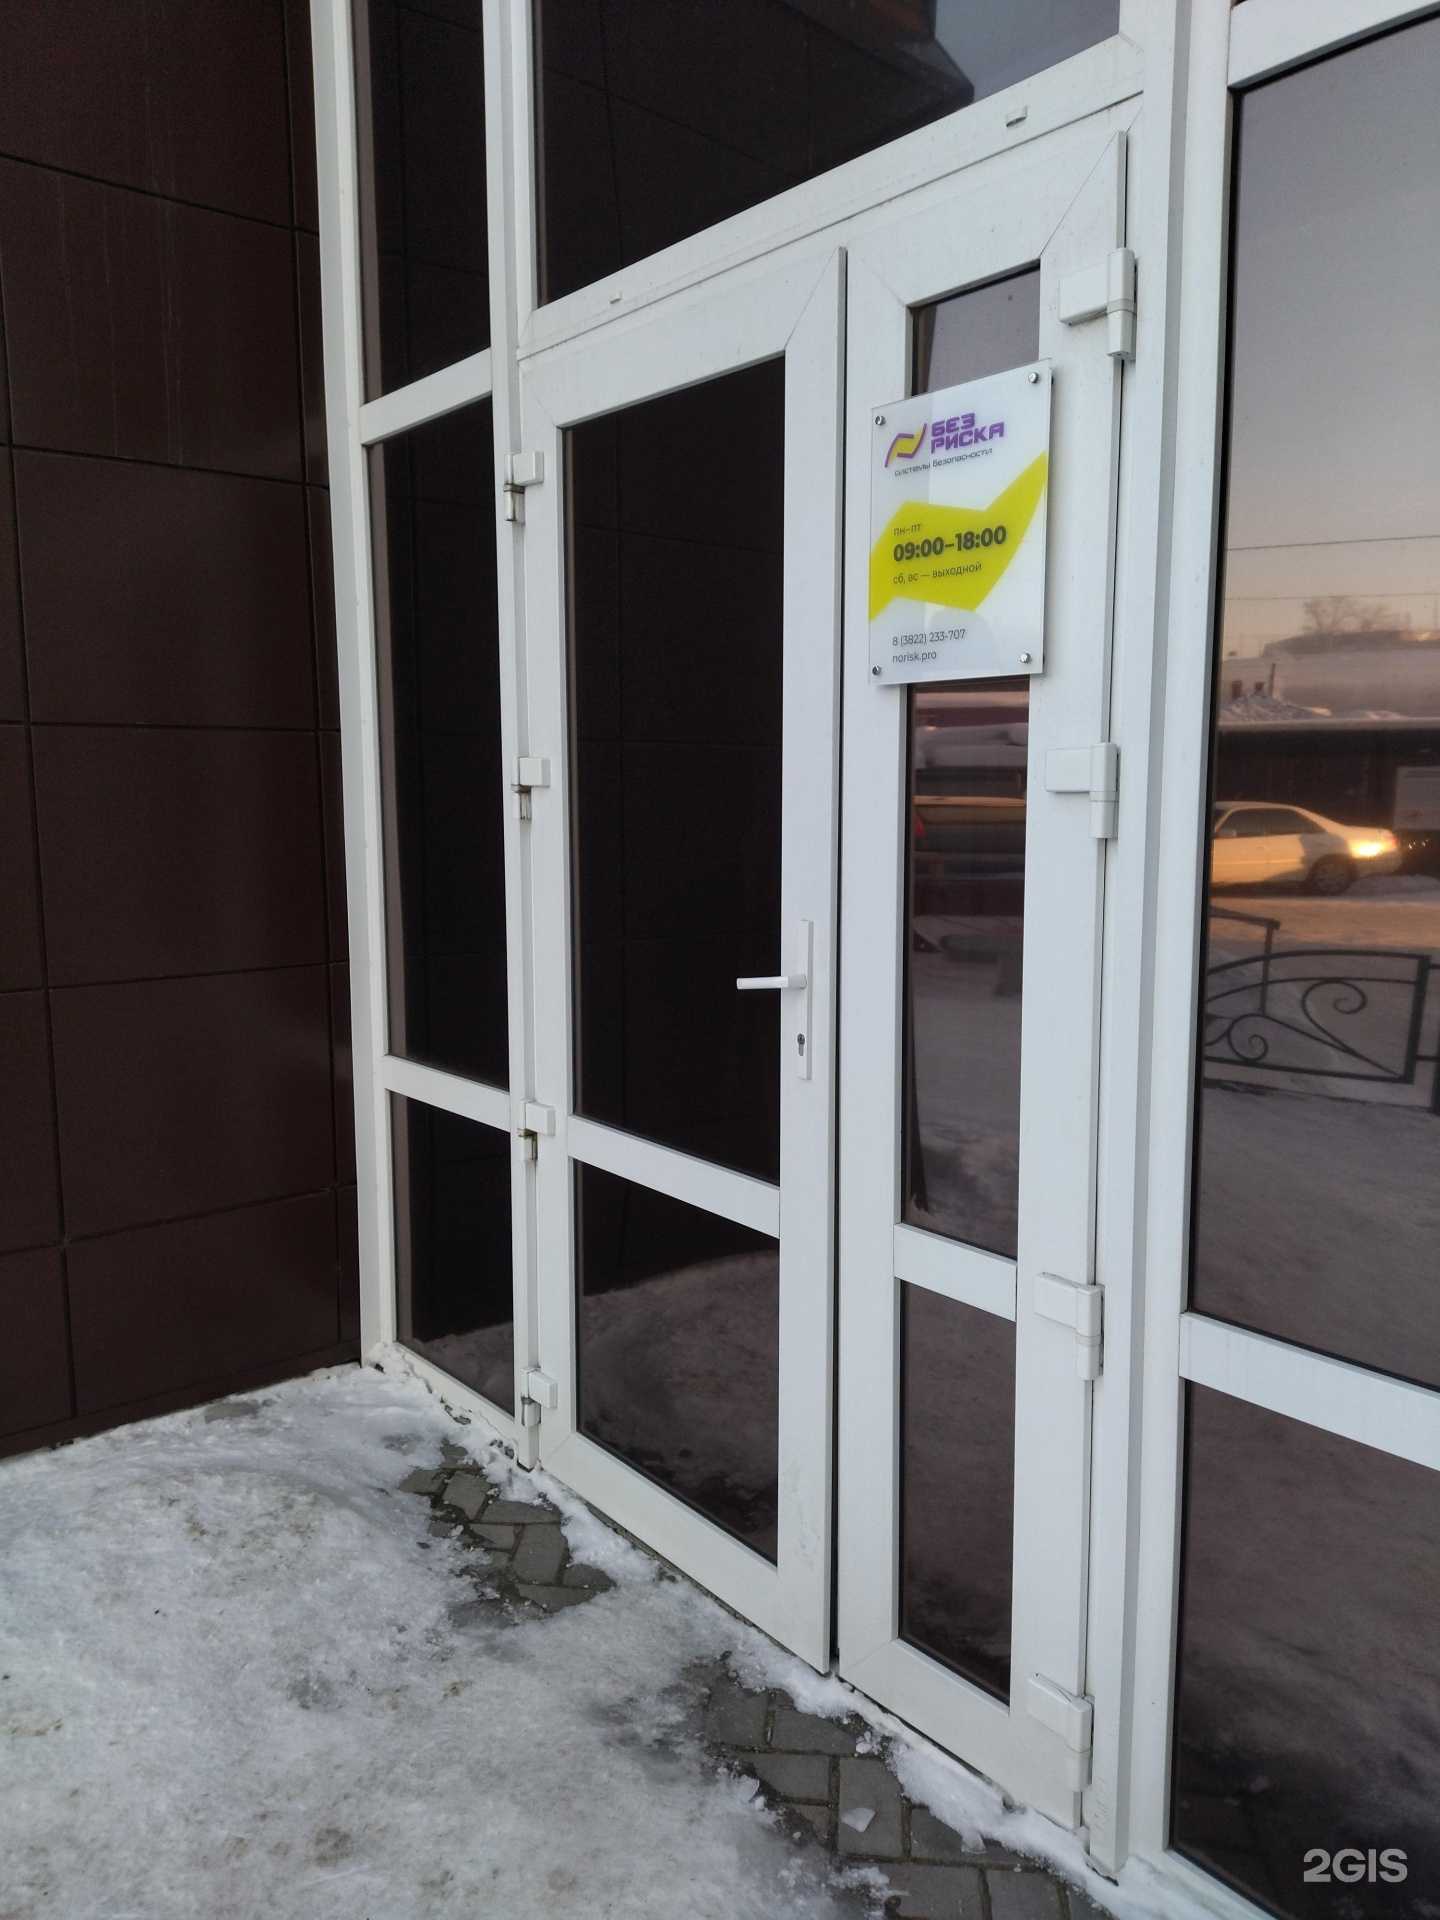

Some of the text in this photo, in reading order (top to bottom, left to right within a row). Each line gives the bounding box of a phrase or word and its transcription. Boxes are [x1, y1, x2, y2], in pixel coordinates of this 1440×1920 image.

[931, 412, 976, 438] БЕЗ
[930, 421, 1005, 454] РИСКА
[932, 448, 993, 467] безопасности
[892, 574, 906, 585] сб,
[907, 572, 919, 583] вс
[932, 561, 982, 579] выходной
[892, 628, 966, 648] 8 (3822) 233-707
[892, 650, 937, 664] norisk.pro
